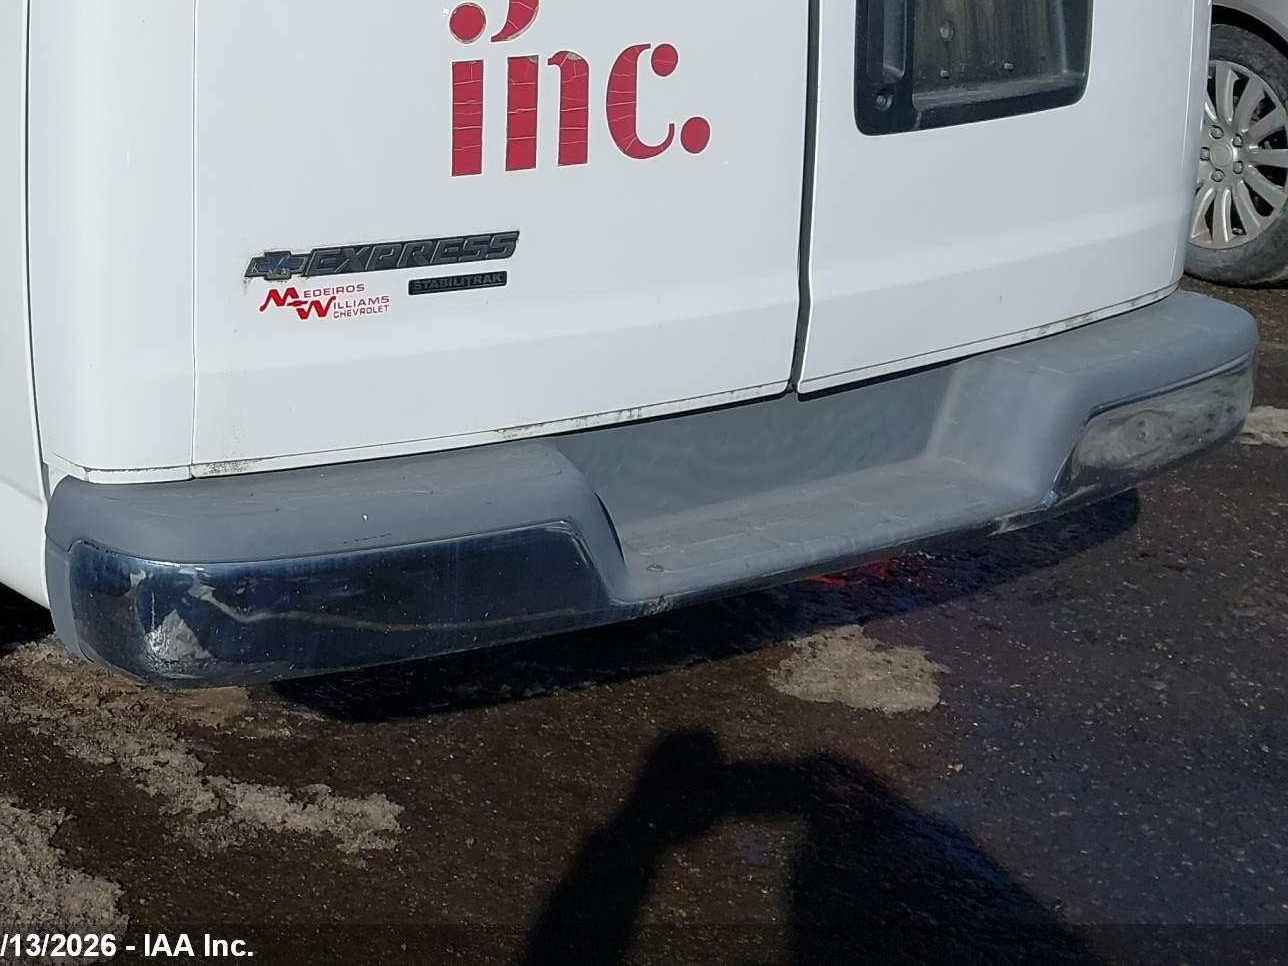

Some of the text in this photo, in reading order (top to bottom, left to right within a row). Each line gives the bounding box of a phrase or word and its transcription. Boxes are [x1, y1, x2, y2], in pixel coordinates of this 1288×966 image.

[450, 43, 711, 177] inc.
[307, 233, 518, 276] EXPRESS
[411, 273, 504, 292] STABILITRAK
[259, 283, 366, 312] MEDEIROS
[296, 295, 390, 320] WILLIAMS
[333, 304, 390, 320] CHEVROLET
